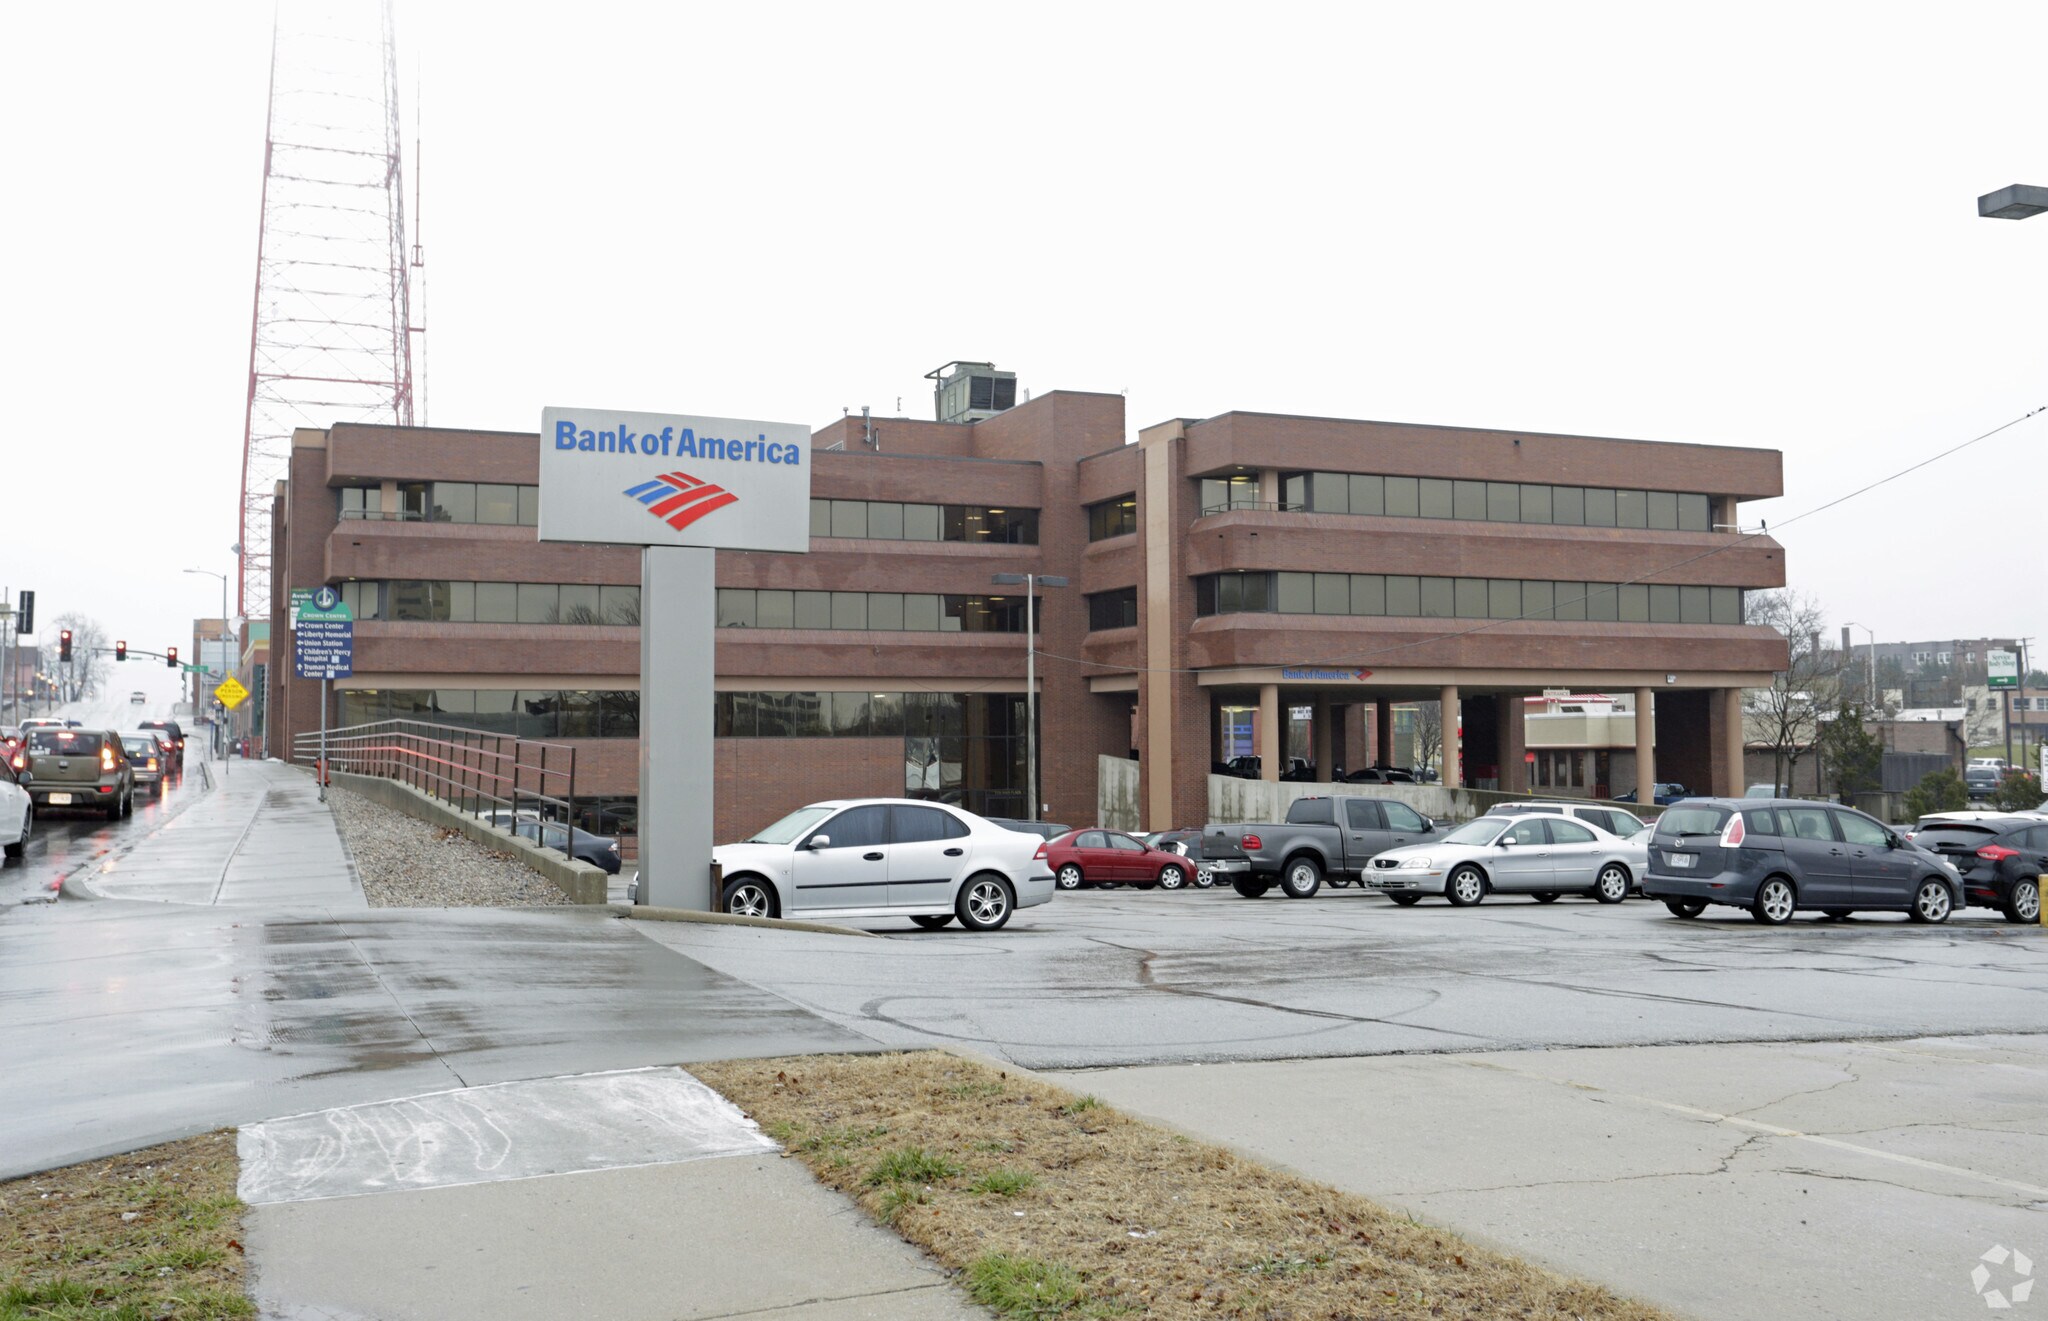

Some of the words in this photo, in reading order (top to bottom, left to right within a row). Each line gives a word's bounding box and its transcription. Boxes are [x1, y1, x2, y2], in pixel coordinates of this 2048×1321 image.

[555, 420, 637, 454] Bank
[641, 426, 673, 456] of
[676, 428, 800, 465] America
[304, 631, 324, 639] Liberty
[1282, 667, 1304, 679] Bank
[1304, 668, 1313, 679] of
[1314, 668, 1350, 680] America
